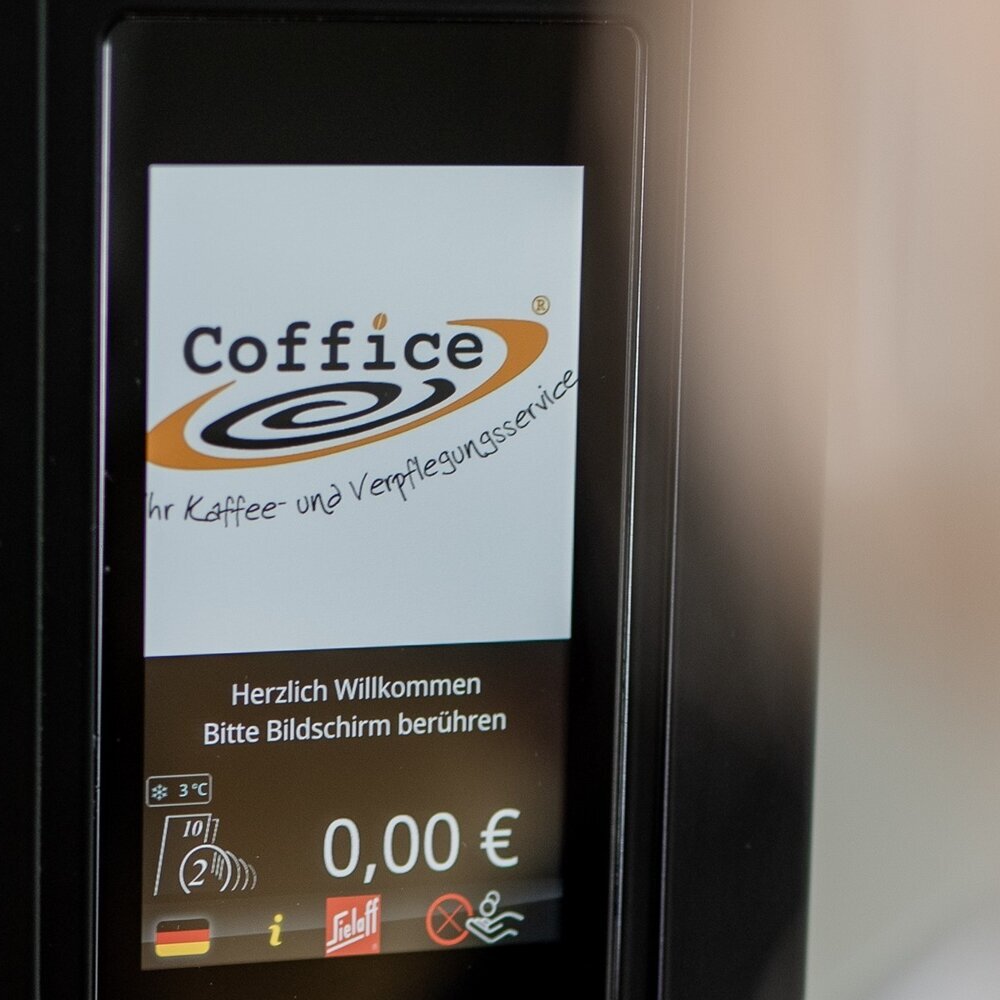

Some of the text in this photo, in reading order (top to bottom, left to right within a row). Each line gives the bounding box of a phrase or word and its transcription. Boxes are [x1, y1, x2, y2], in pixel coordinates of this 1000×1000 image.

[183, 313, 484, 374] Coffice
[145, 369, 578, 527] hr Kaffee- und Verpflegungsservice
[232, 676, 481, 706] Herzlich Willkommen
[203, 709, 507, 745] Bitte Bildschirm berühren
[182, 819, 204, 838] 10
[323, 808, 521, 885] 0,00 €
